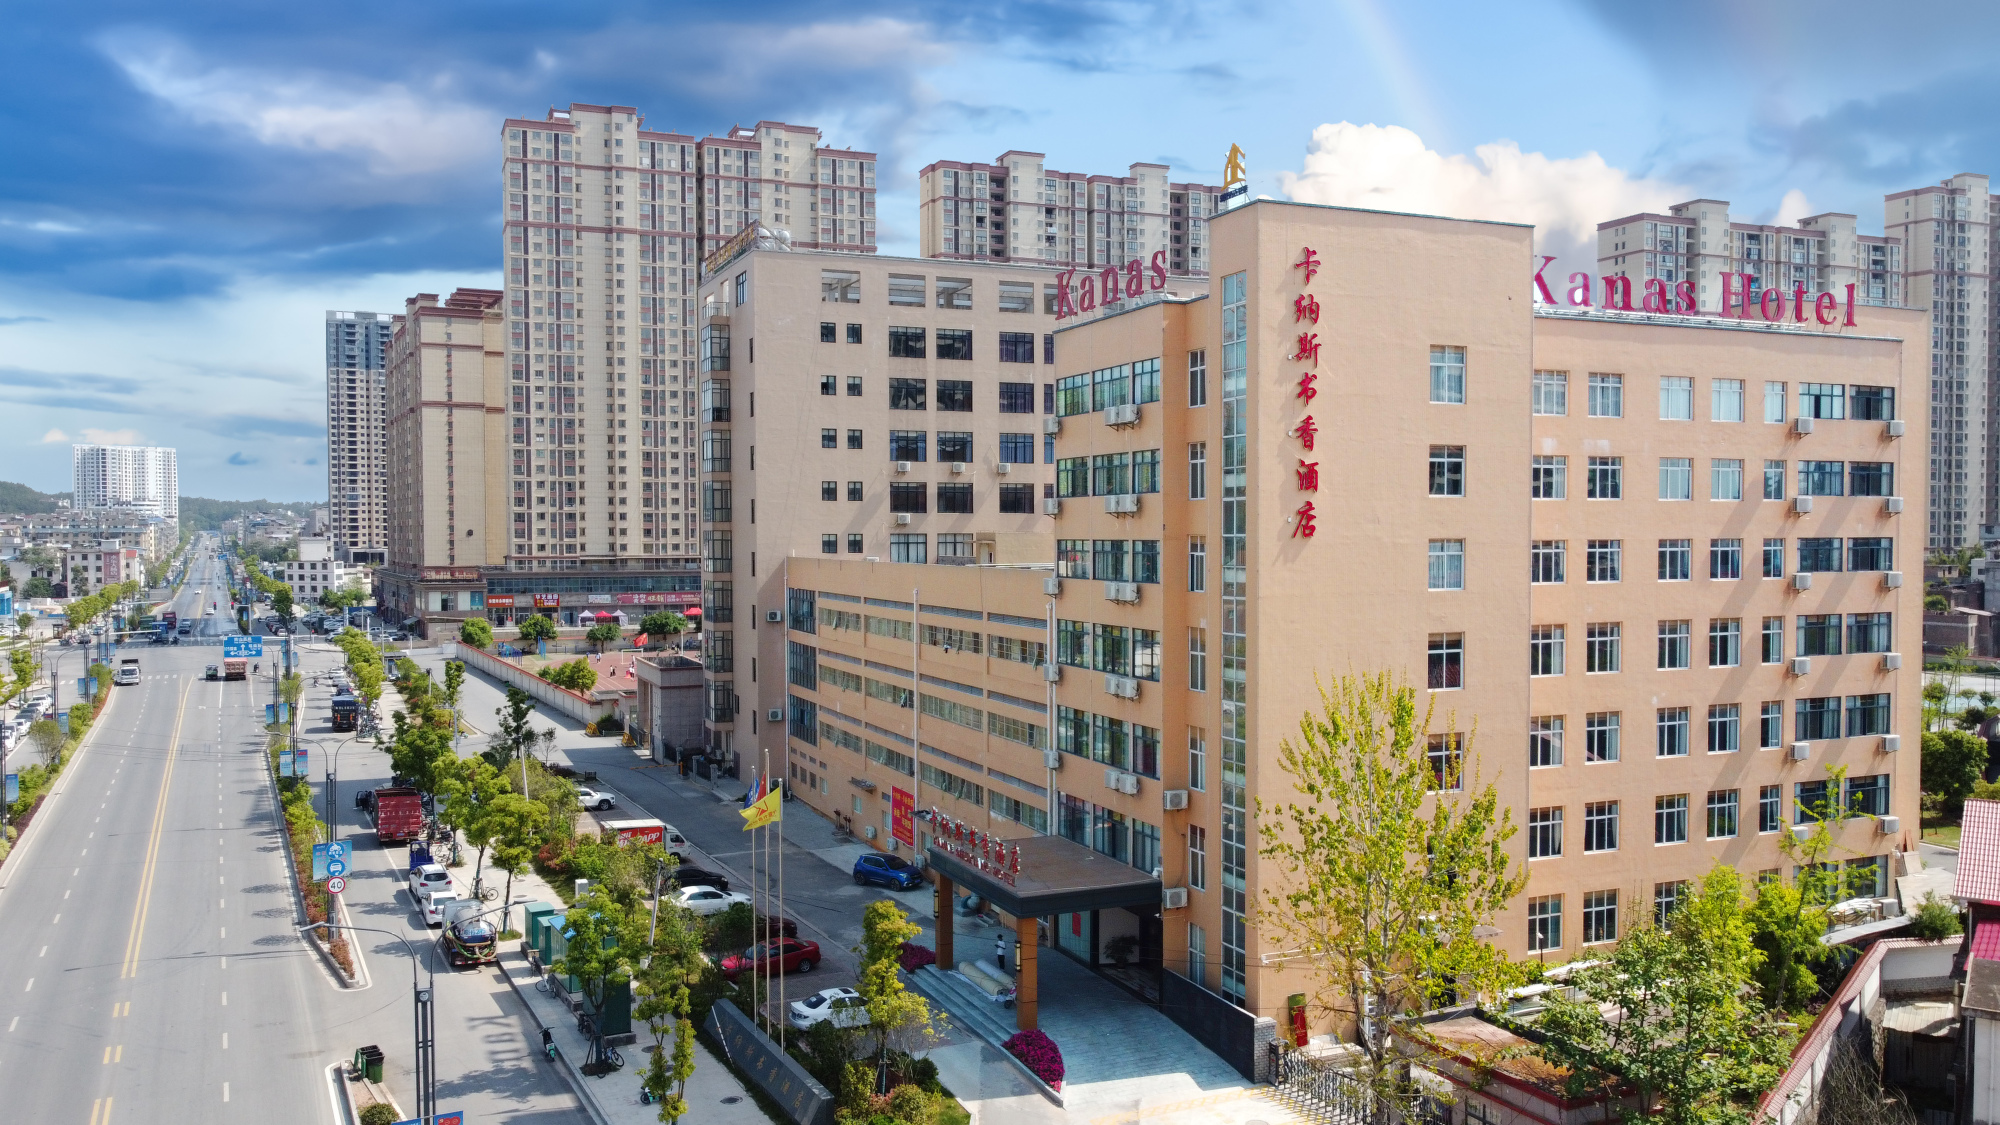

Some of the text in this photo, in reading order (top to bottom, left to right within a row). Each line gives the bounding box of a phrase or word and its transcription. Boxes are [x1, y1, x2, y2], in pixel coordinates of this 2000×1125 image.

[1055, 250, 1167, 321] Kanas
[1719, 271, 1858, 328] Hotel
[1292, 246, 1322, 539] 卡纳斯书香酒店
[331, 881, 342, 890] 40
